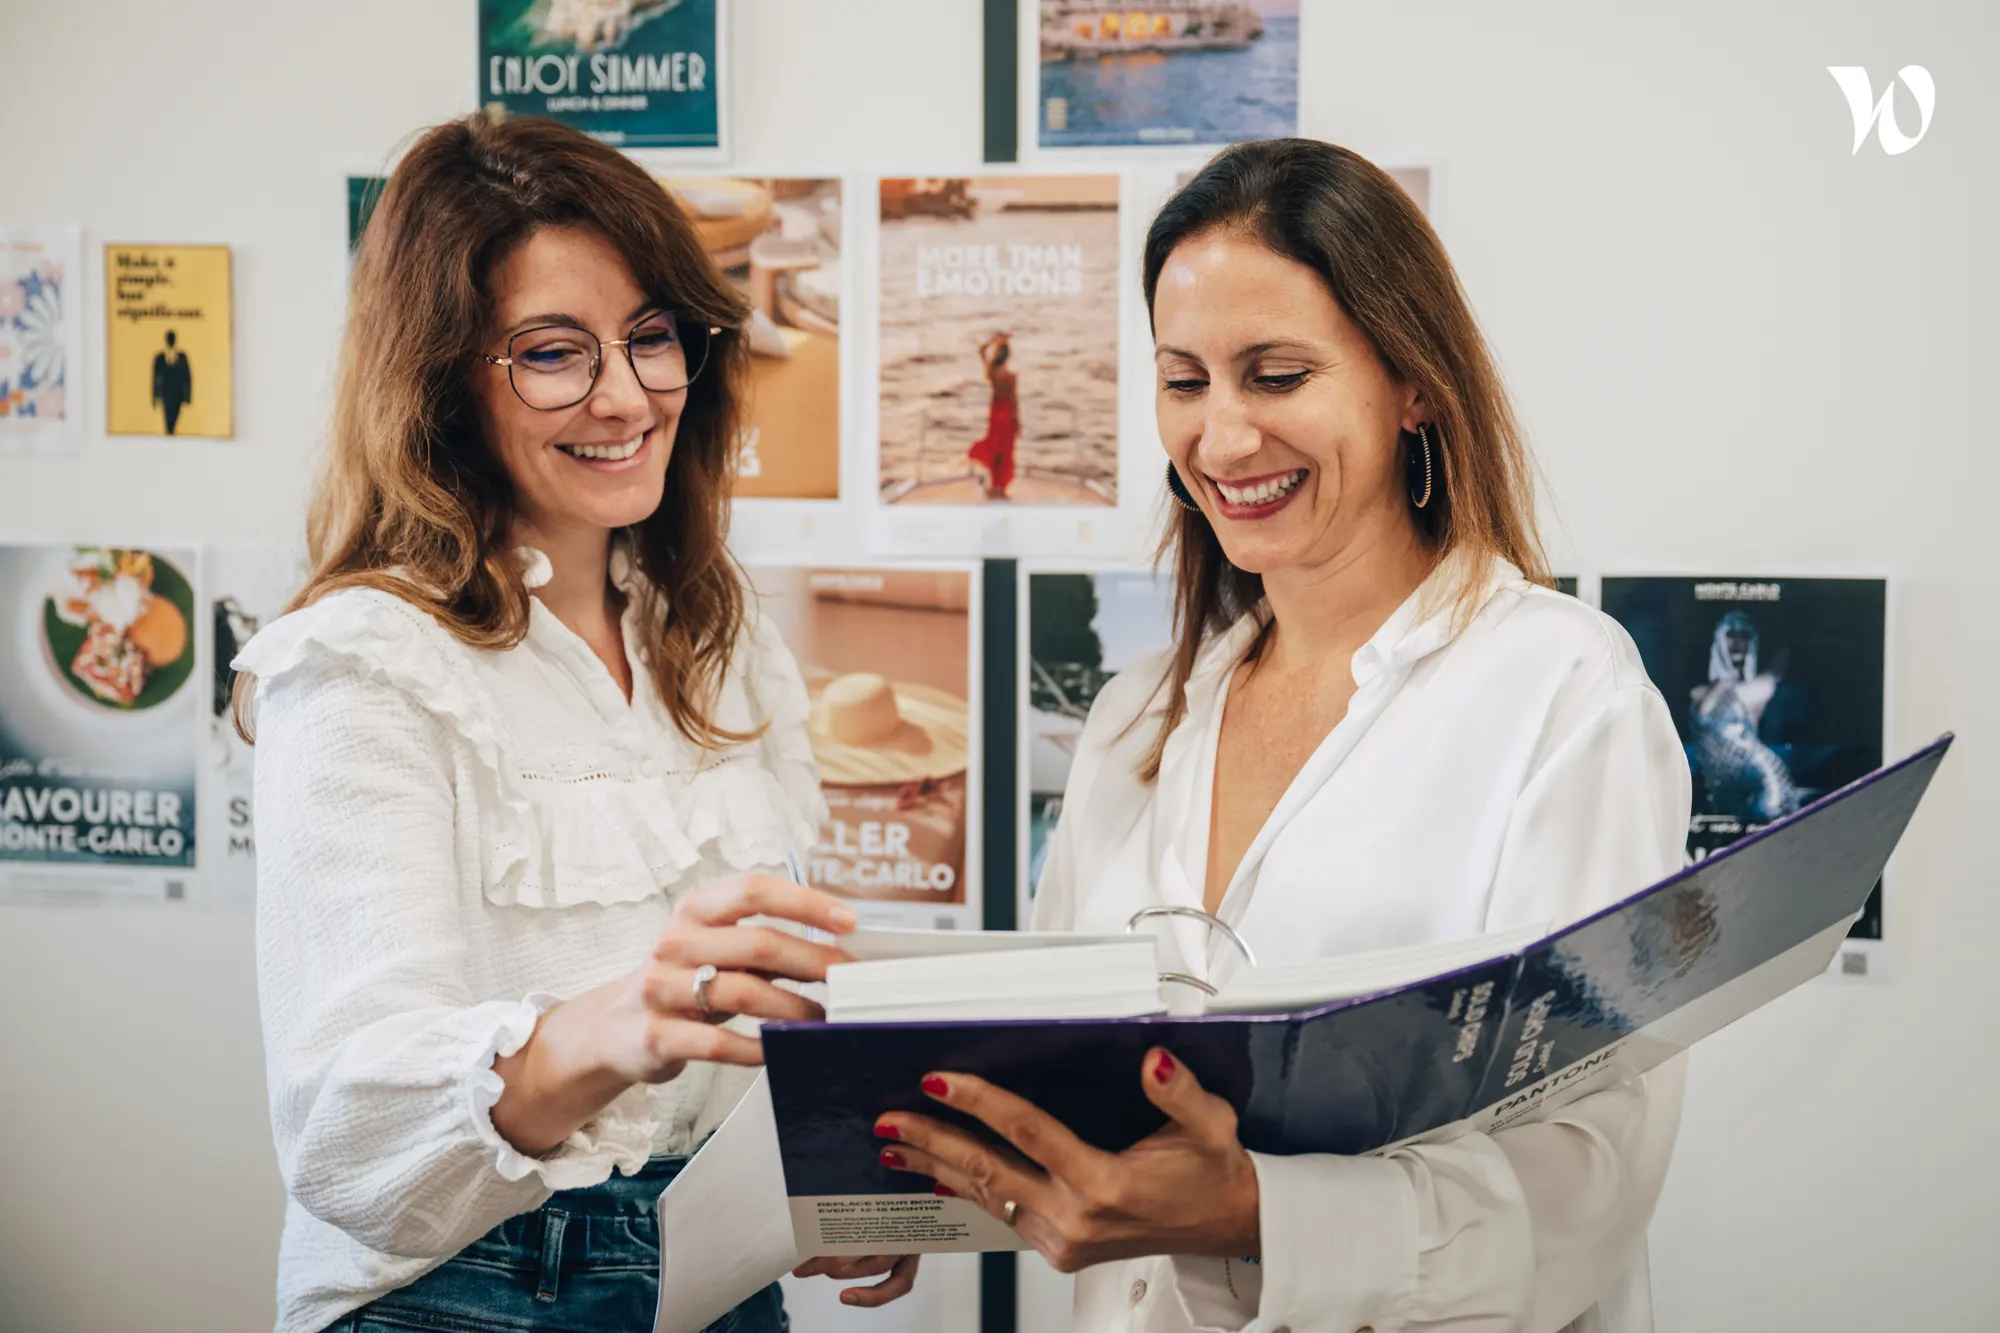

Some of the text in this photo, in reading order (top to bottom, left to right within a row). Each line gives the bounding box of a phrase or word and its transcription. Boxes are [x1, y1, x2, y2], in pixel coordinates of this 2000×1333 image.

[490, 52, 706, 95] ENJOY SUMMER
[116, 253, 158, 268] Make
[917, 243, 1082, 268] MORE THAN
[917, 267, 1082, 297] EMOTIONS
